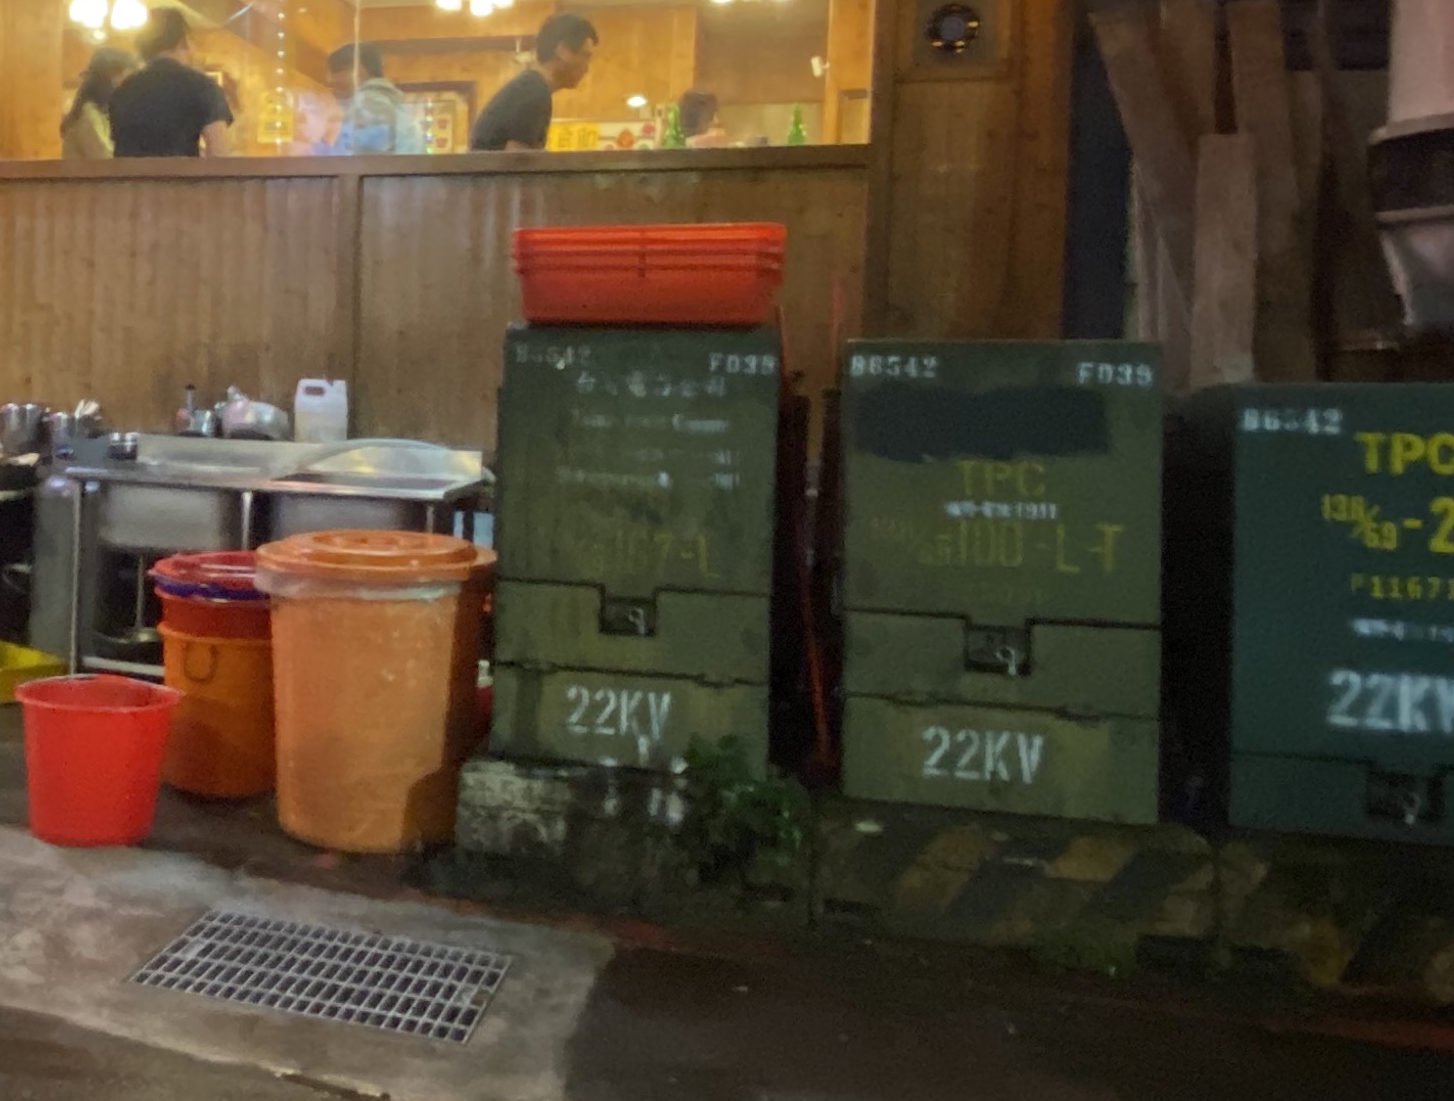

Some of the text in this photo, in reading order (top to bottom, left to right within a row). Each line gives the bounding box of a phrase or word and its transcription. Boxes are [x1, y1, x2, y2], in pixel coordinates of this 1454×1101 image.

[957, 459, 1047, 497] TPC
[1353, 430, 1454, 477] TPC
[564, 682, 672, 741] 22KV
[921, 725, 1044, 785] 22KV
